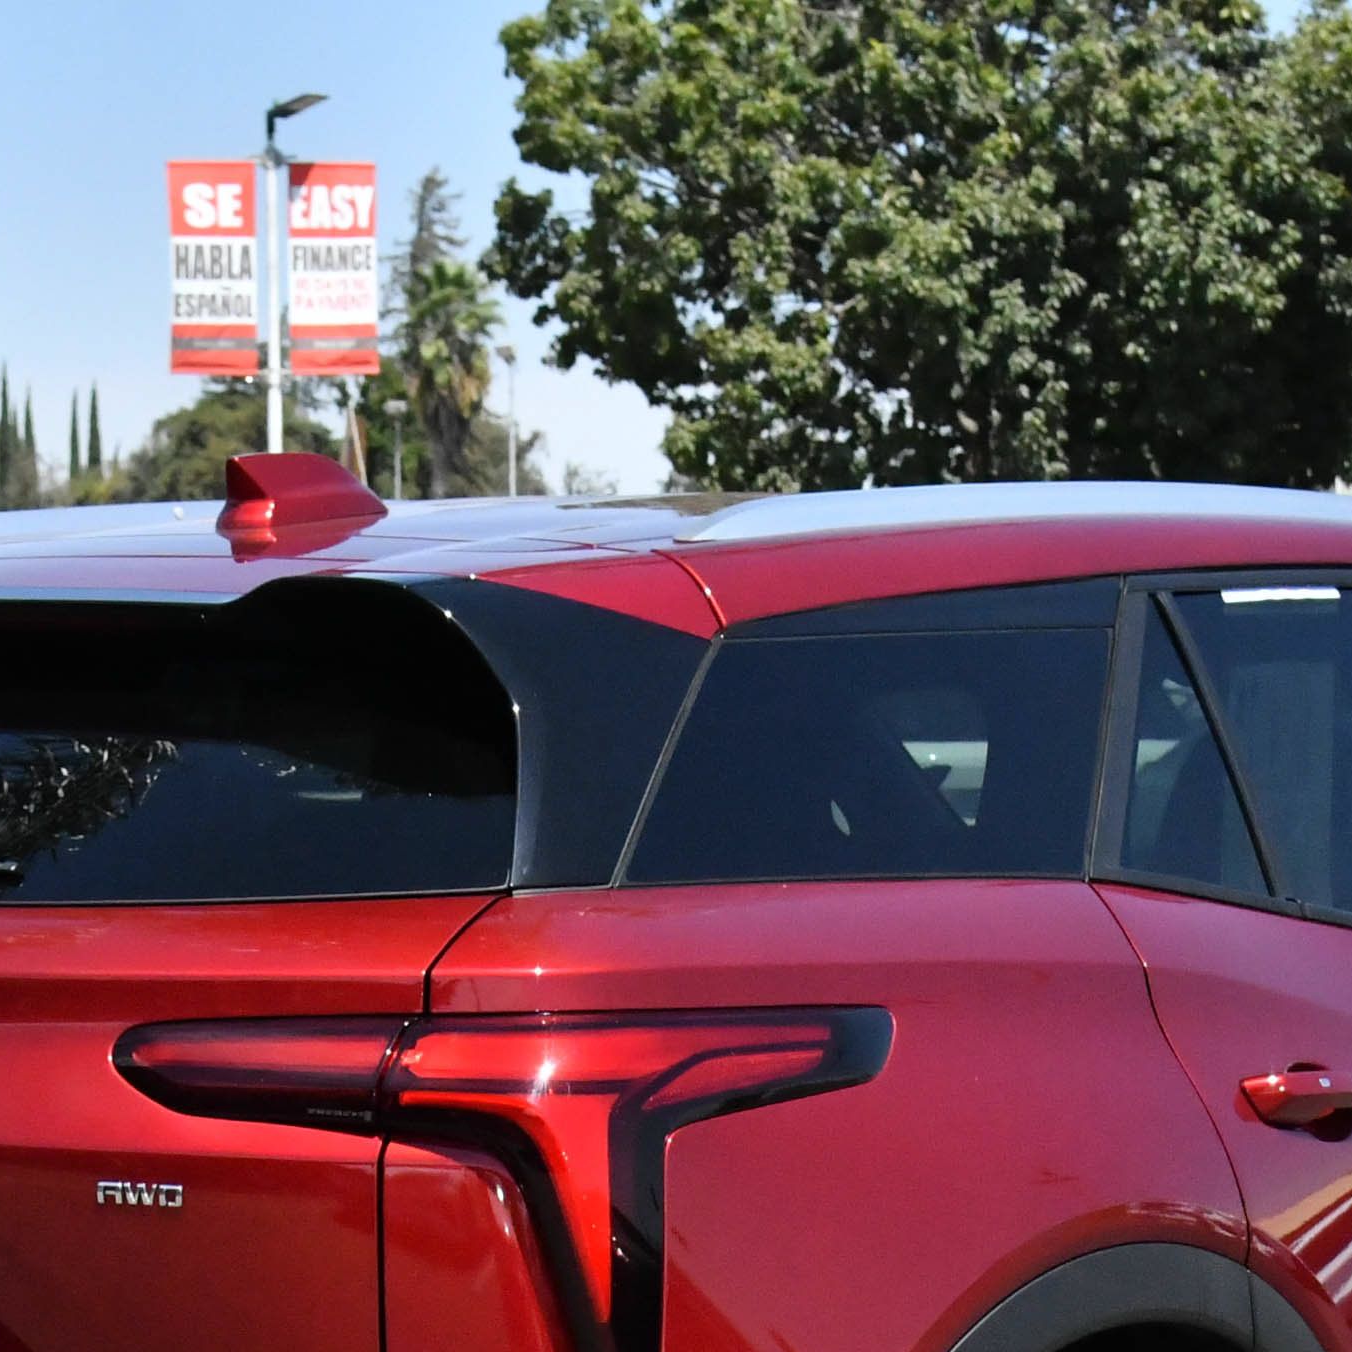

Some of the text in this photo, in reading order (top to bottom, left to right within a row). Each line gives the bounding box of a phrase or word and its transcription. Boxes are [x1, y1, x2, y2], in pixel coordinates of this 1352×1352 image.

[182, 182, 243, 229] SE
[290, 184, 374, 230] EASY
[174, 243, 253, 281] HABLA
[292, 244, 372, 272] FINANCE
[174, 286, 253, 318] ESPAÑOL
[97, 1180, 184, 1208] AWD
